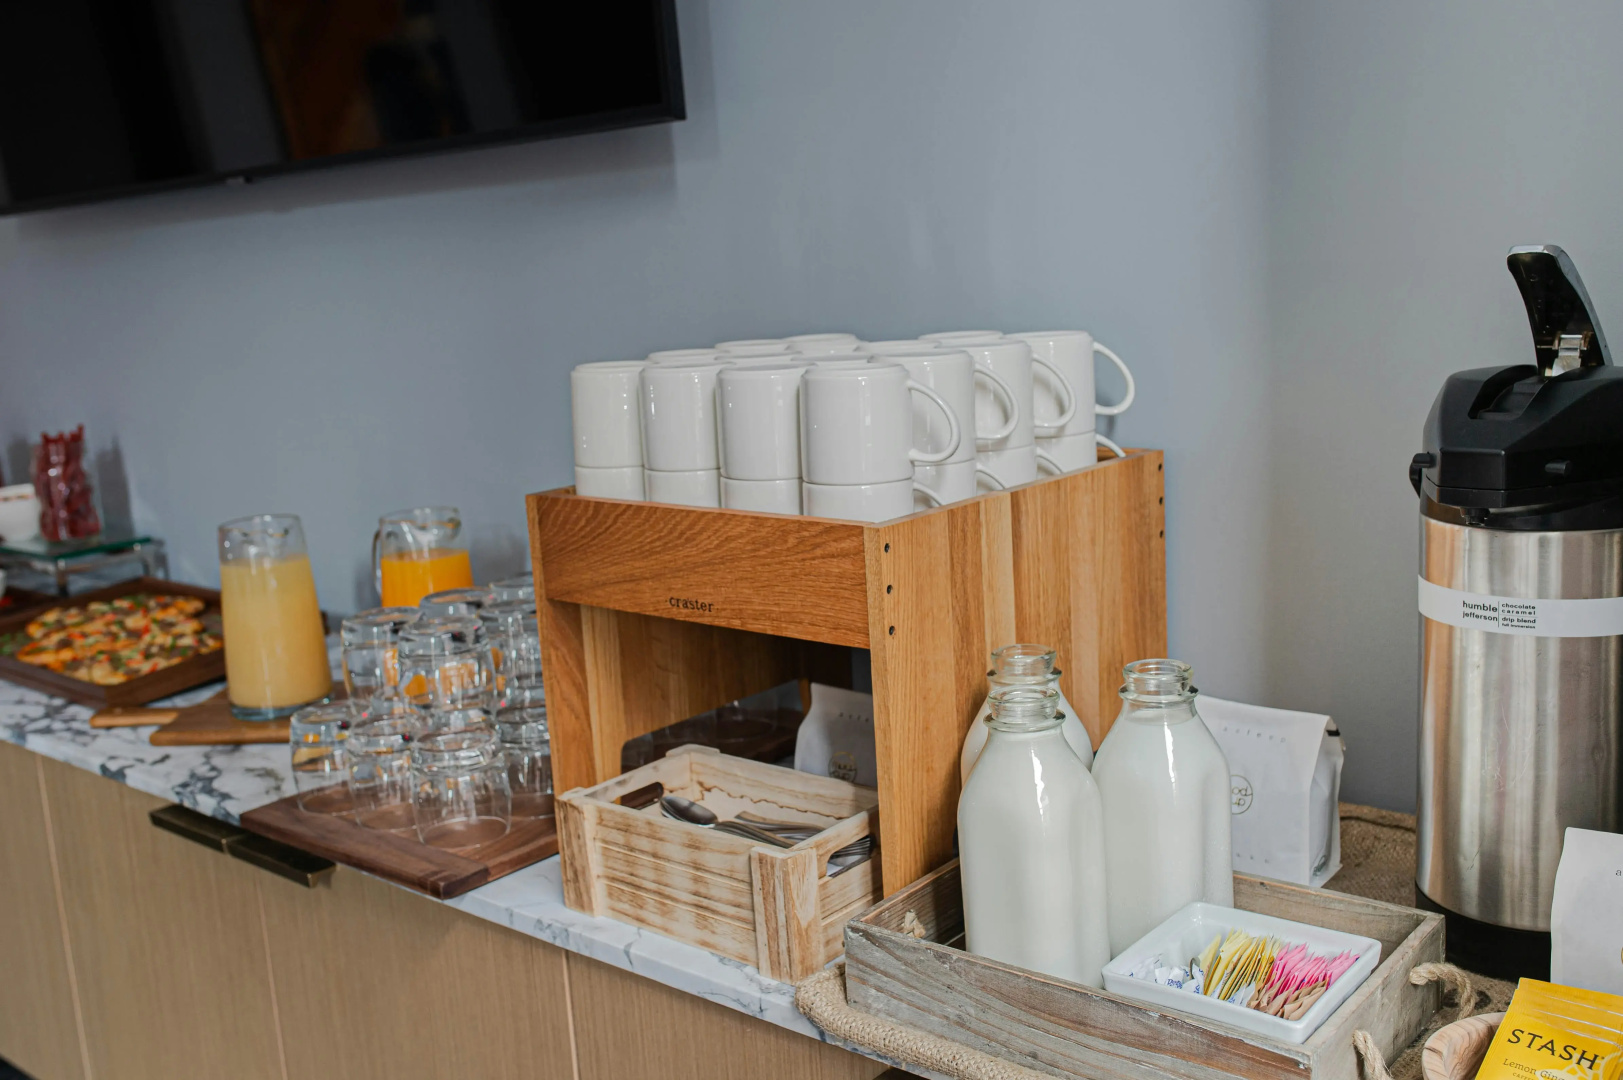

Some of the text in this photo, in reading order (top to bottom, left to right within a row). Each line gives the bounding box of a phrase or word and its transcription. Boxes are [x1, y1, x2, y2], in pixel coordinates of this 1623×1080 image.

[669, 596, 714, 612] craster
[1463, 600, 1498, 612] humble
[1463, 611, 1498, 622] jefferson
[1507, 1028, 1600, 1071] STASH
[1503, 1058, 1537, 1075] Lemon
